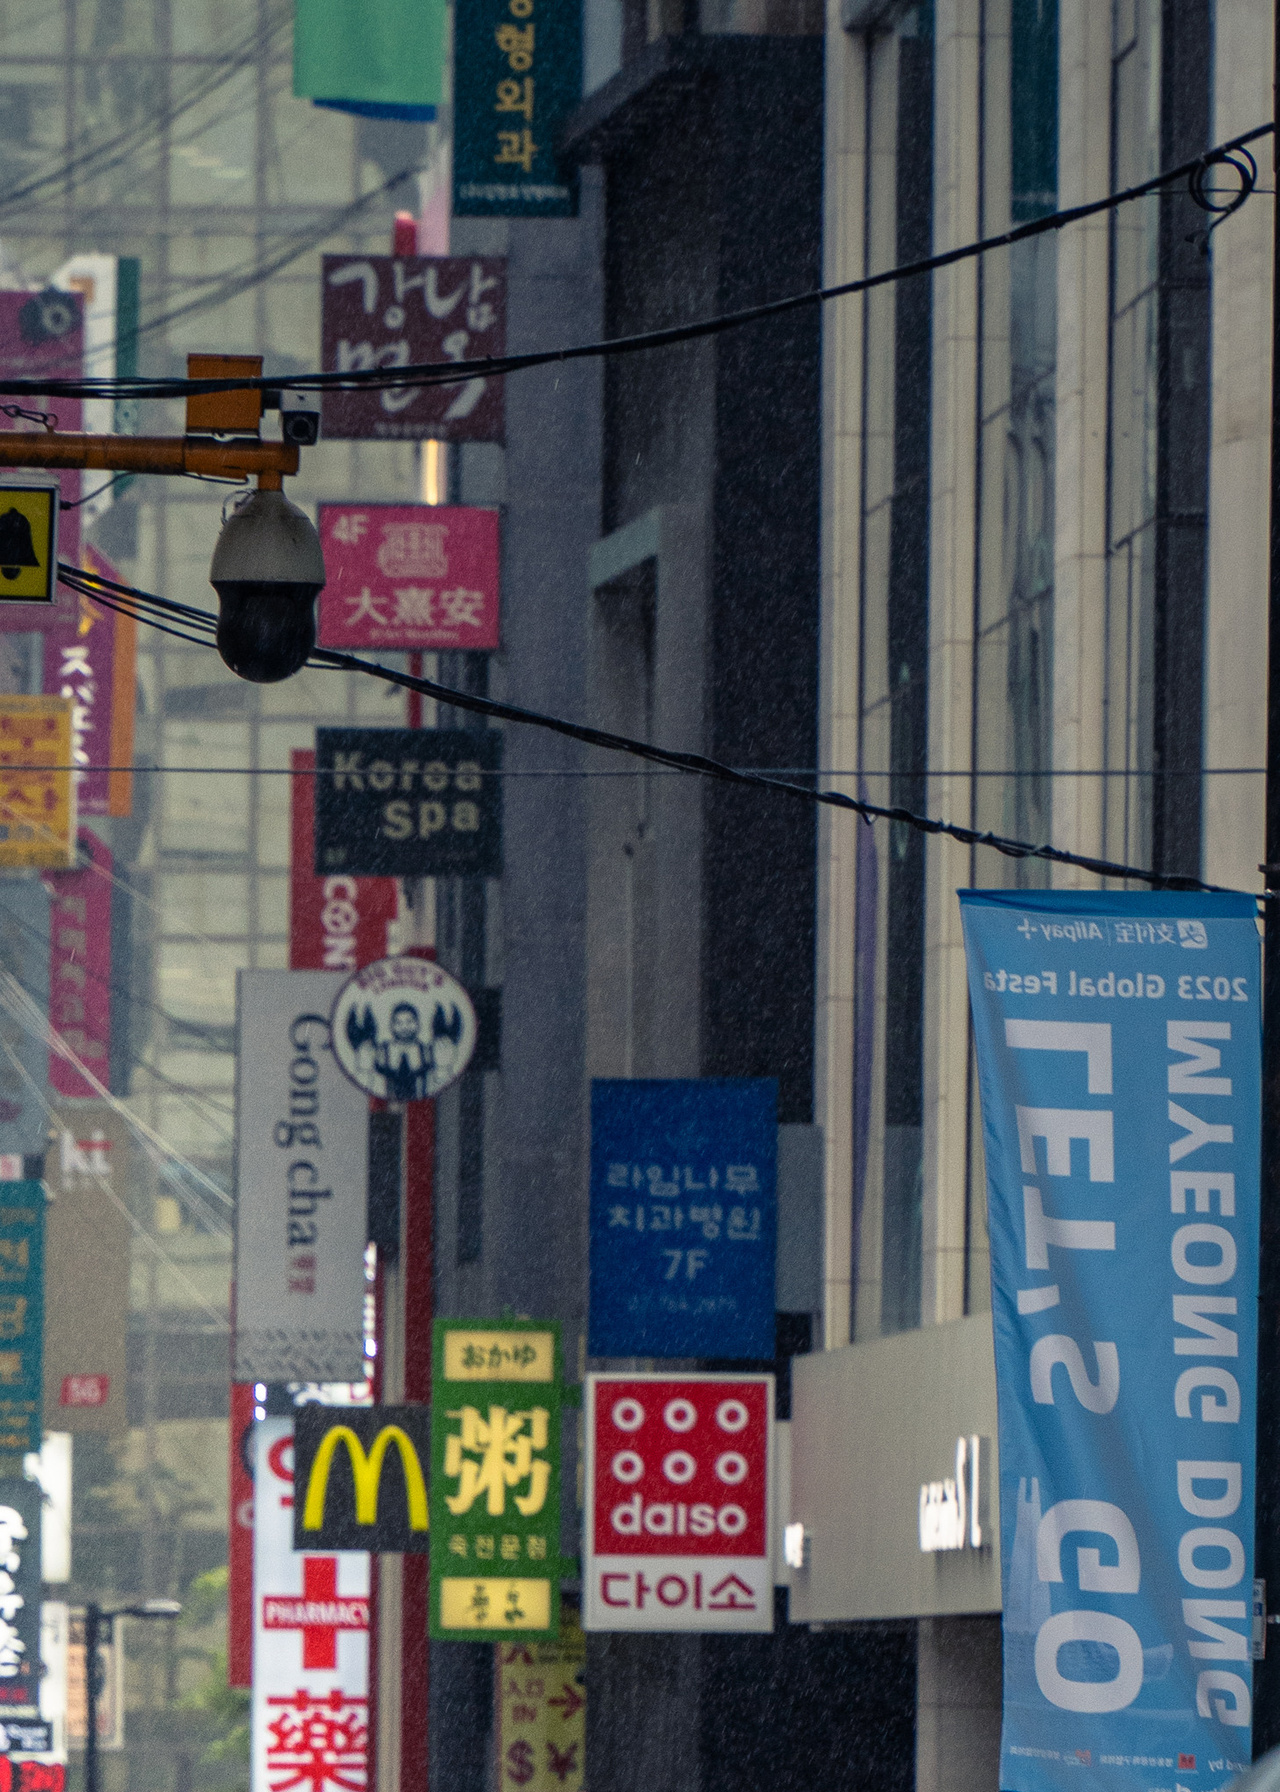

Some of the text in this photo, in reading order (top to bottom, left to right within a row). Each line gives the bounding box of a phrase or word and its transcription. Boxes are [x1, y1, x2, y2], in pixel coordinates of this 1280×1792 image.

[332, 513, 368, 544] 4F
[333, 751, 483, 791] Korea
[274, 1011, 332, 1247] Gong cha
[606, 1163, 760, 1197] 라임나무
[607, 1202, 761, 1241] 치과병원
[664, 1249, 708, 1280] 7F
[461, 1343, 537, 1369] おかゆ
[444, 1405, 550, 1516] 粥
[611, 1493, 748, 1537] daiso
[600, 1572, 757, 1611] 다이소
[265, 1602, 369, 1625] PHARMACY
